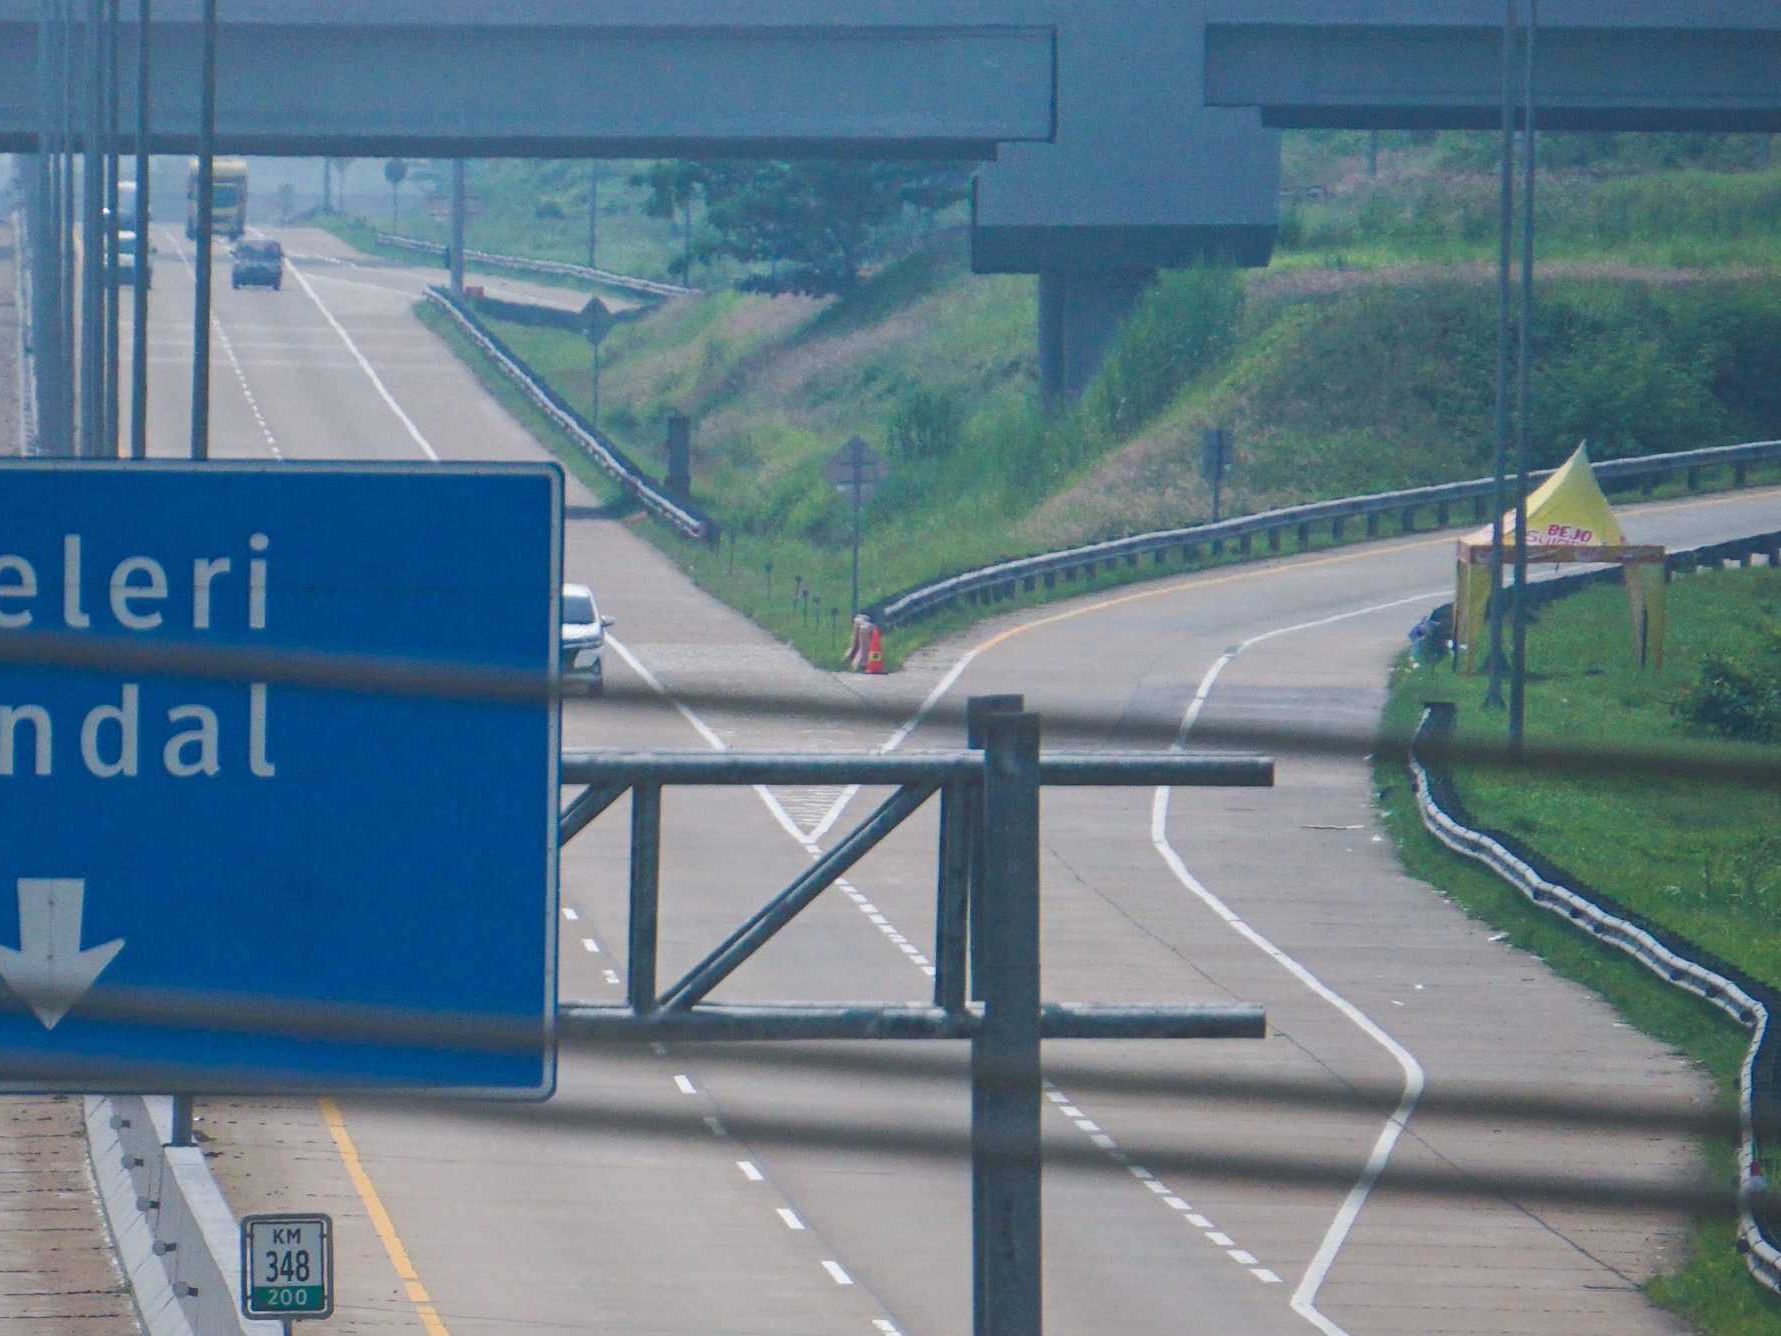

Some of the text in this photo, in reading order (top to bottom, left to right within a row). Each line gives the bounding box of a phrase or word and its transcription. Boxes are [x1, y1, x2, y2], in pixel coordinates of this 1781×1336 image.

[1548, 523, 1593, 543] BEJO
[273, 1228, 301, 1244] KM
[265, 1249, 310, 1283] 348
[267, 1288, 308, 1306] 200
